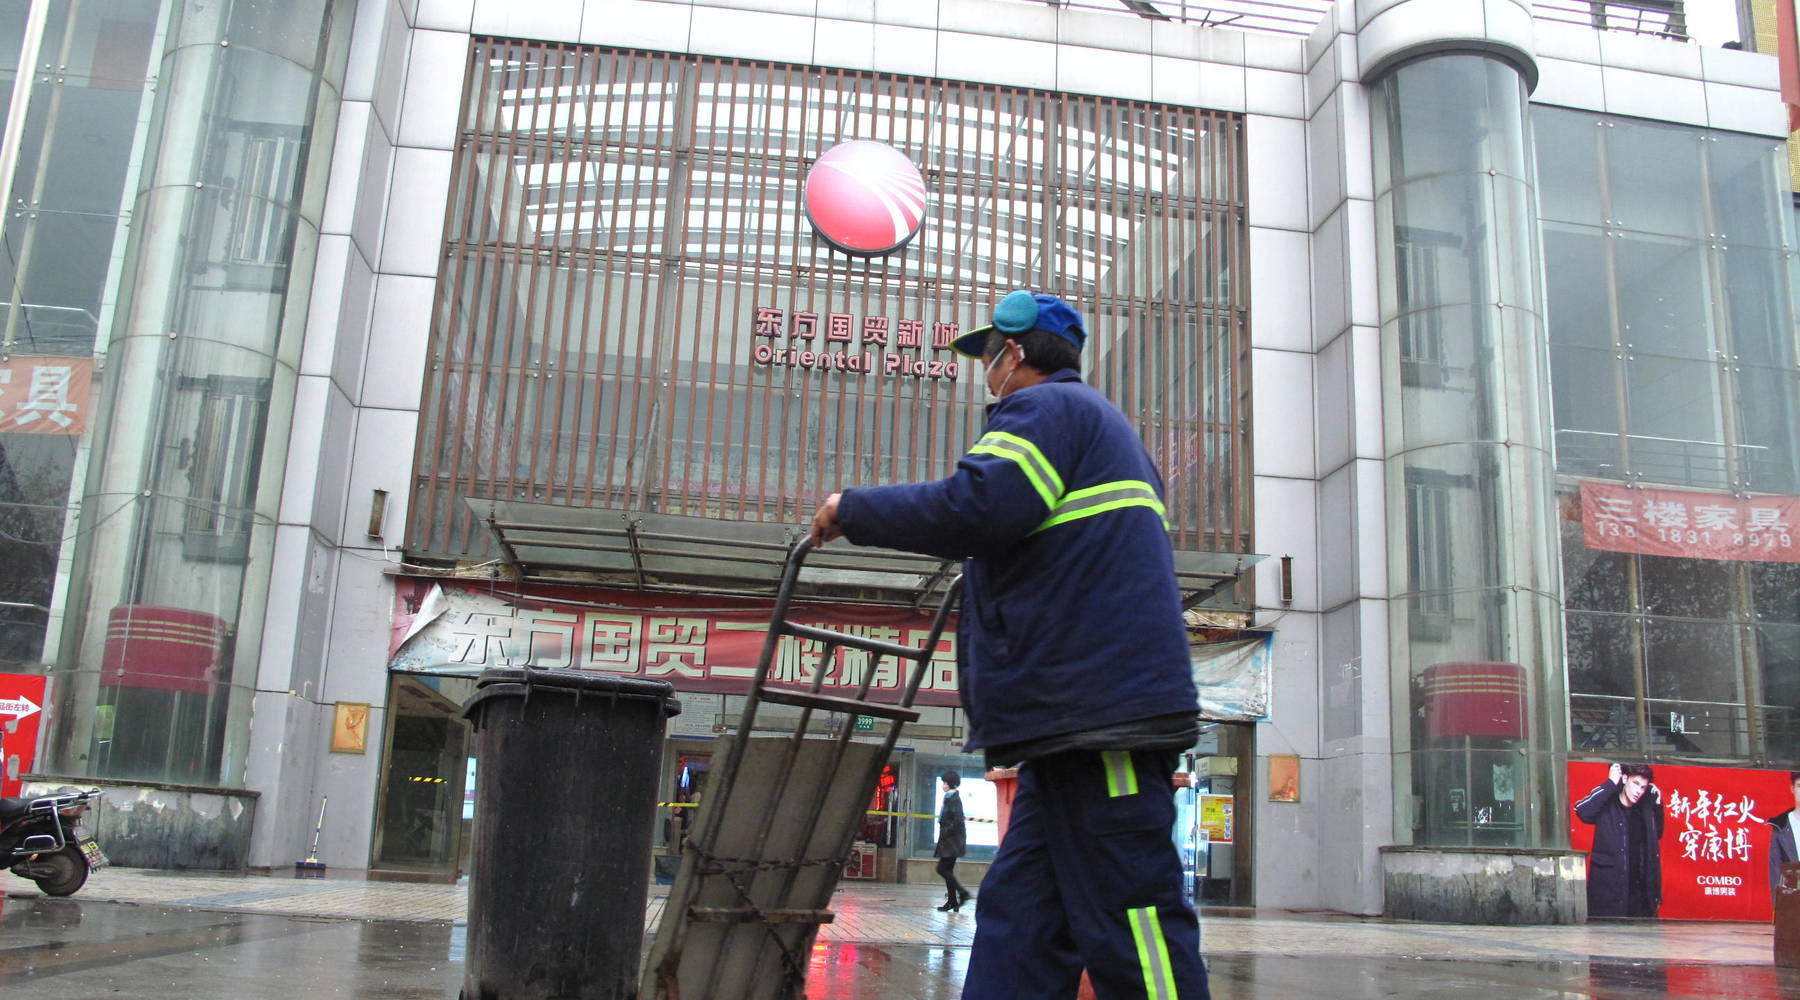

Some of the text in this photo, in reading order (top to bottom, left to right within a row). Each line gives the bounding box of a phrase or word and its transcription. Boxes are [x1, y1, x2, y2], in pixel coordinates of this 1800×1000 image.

[757, 307, 960, 350] 东方国贸新城
[754, 344, 960, 380] Oriental Plaza
[1594, 497, 1790, 532] 三楼家具
[1595, 521, 1792, 548] 138 1831 8979
[449, 606, 959, 691] 东方国贸二楼精品
[1666, 789, 1765, 828] 新年红火
[1679, 823, 1752, 862] 穿康博
[1696, 875, 1742, 886] COMBO
